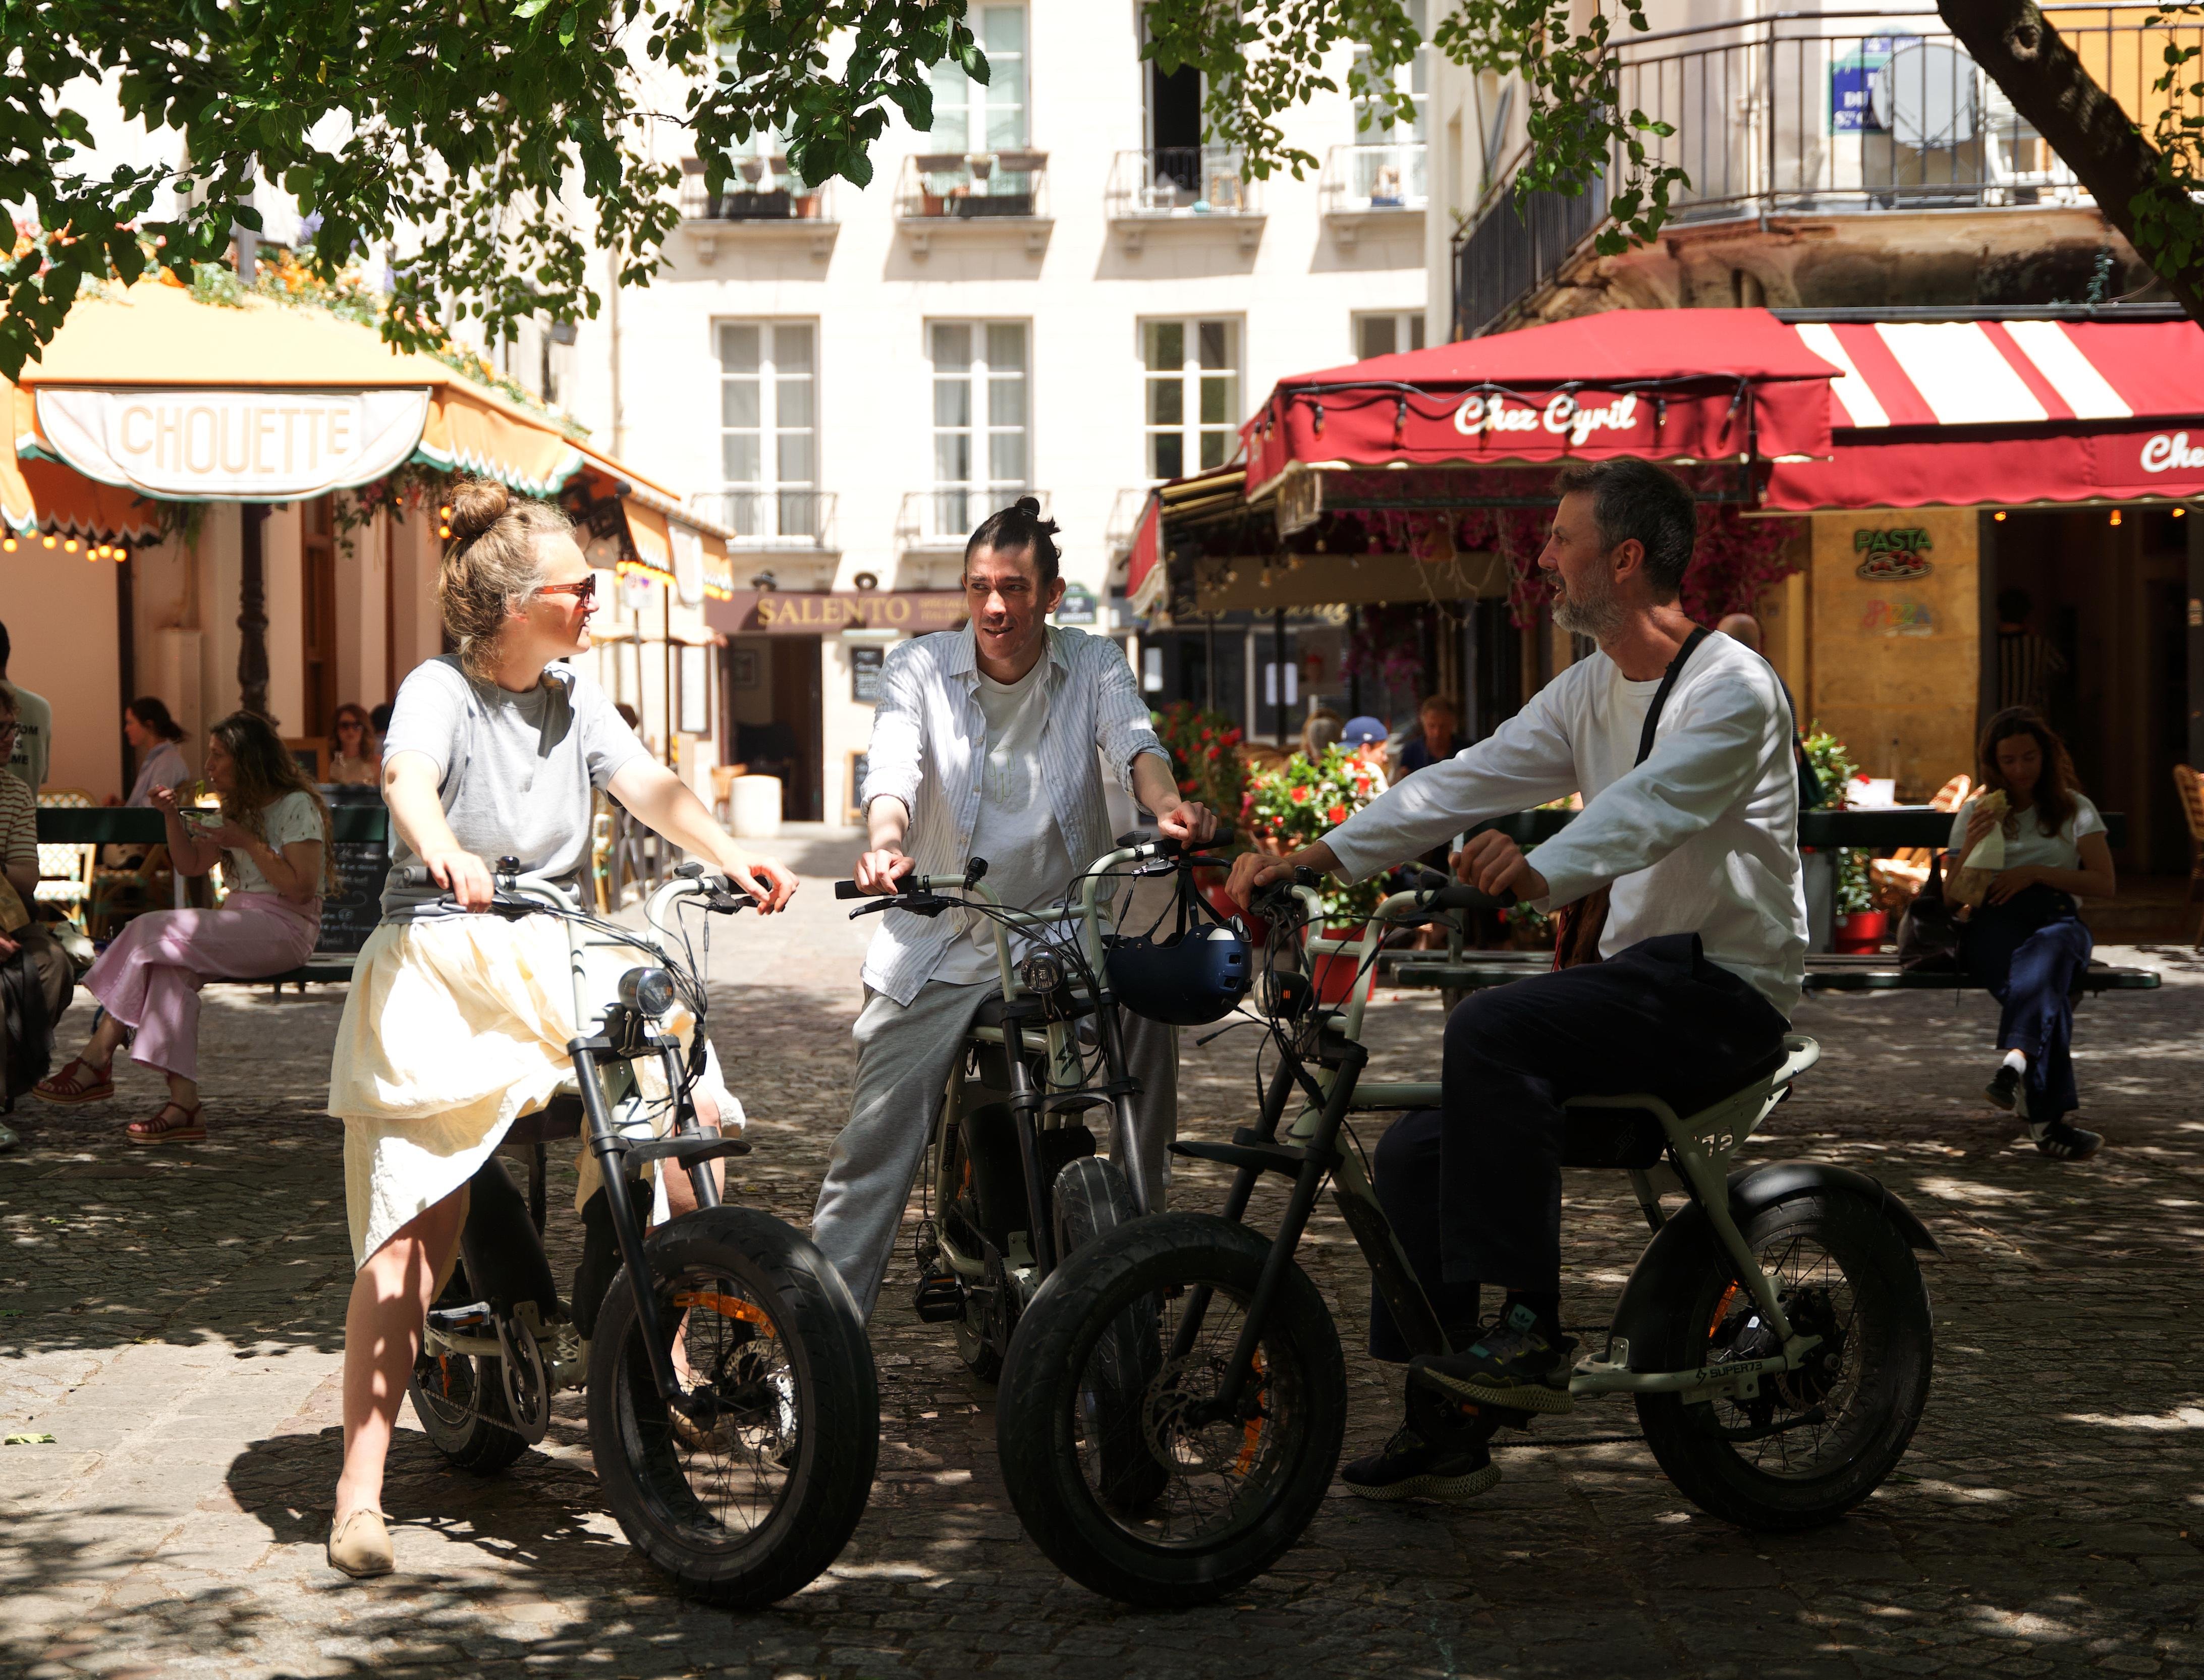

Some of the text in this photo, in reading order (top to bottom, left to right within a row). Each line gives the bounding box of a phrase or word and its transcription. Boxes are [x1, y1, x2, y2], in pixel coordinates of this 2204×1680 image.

[1454, 391, 1637, 446] Chez Cyril
[121, 404, 350, 474] CHOUETTE
[1855, 530, 1933, 552] PASTA
[757, 596, 911, 625] SALENTO
[1863, 599, 1932, 627] PIZZA
[1710, 1362, 1763, 1378] SUPER73
